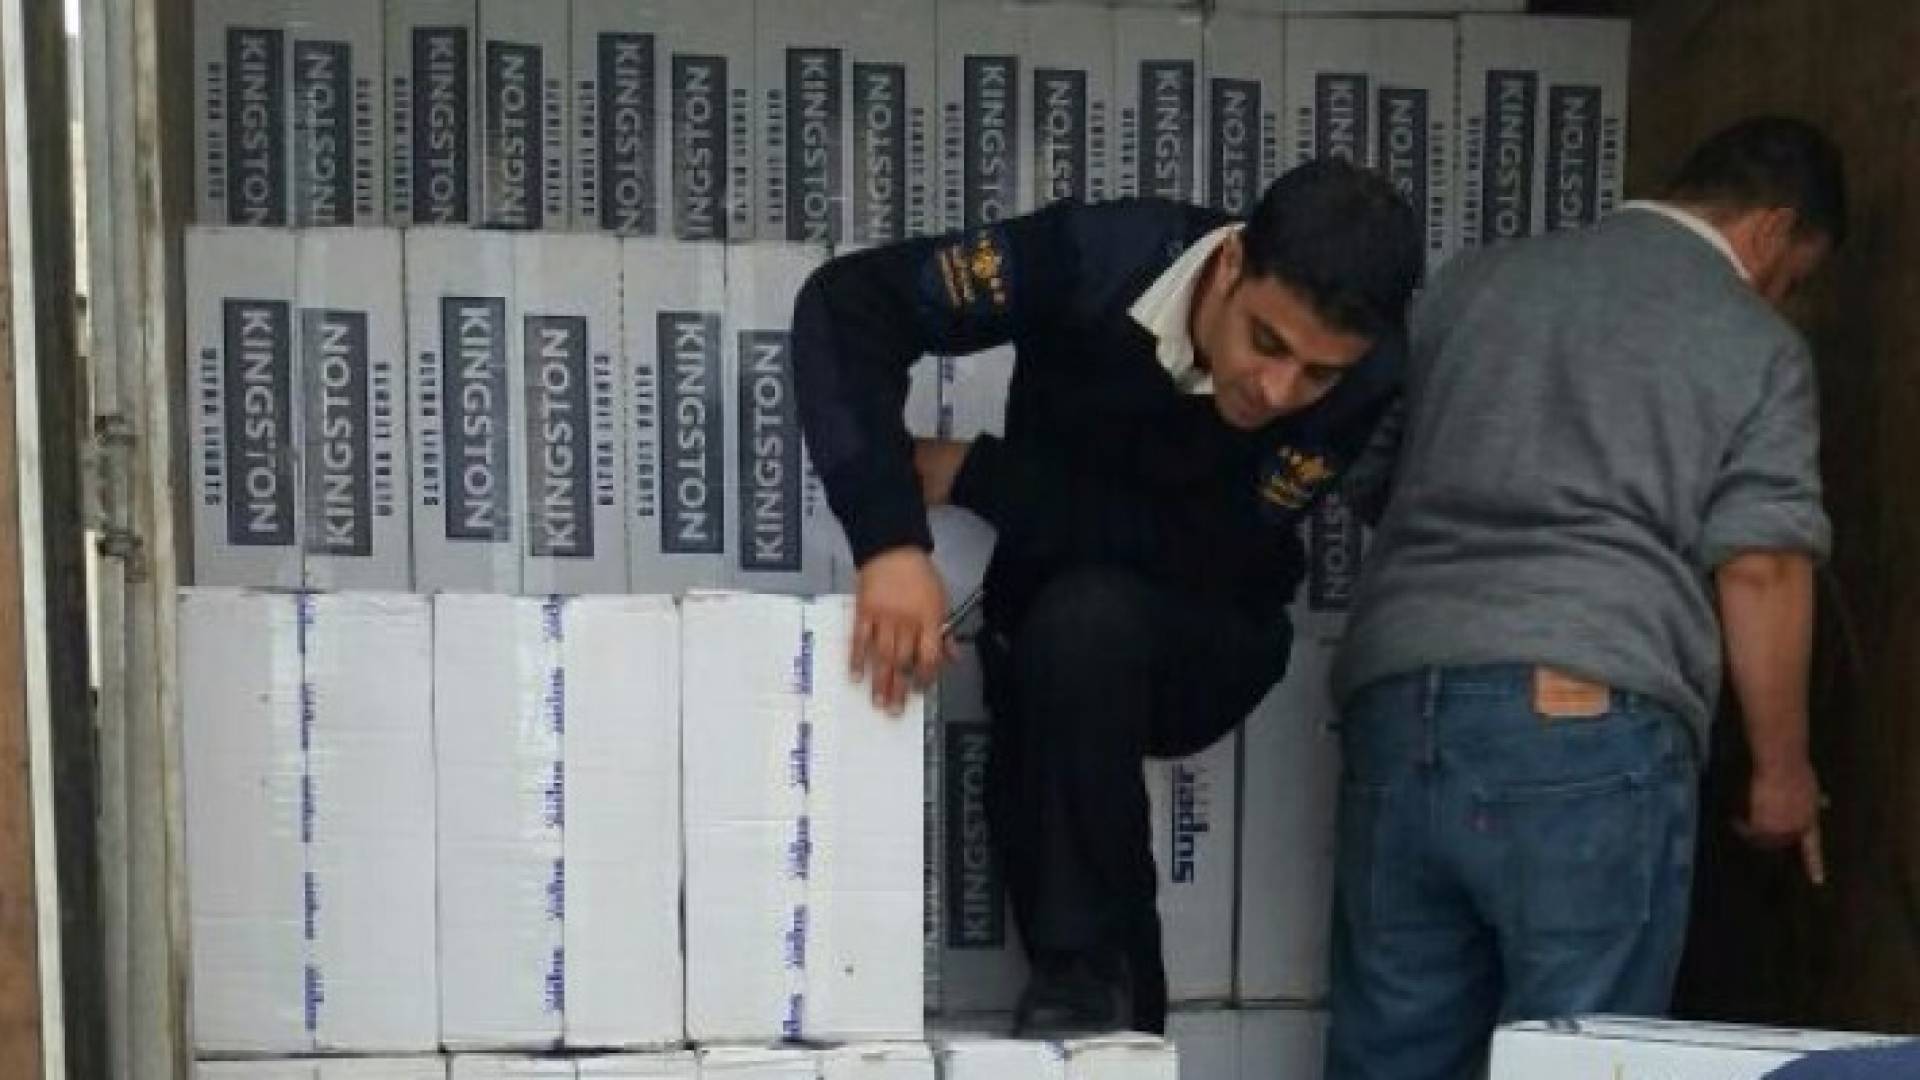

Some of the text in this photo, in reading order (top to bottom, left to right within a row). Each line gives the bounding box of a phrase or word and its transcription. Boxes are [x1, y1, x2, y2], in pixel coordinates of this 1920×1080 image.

[305, 52, 335, 224] INGSTON
[502, 52, 527, 225] INGSTON
[615, 42, 643, 237] KINGSTON
[686, 65, 713, 236] INGSTON
[801, 56, 829, 243] KINGSTON
[866, 74, 892, 238] INGSTON
[980, 66, 1006, 223] KINGSTO
[1048, 80, 1072, 202] GSTON
[1155, 70, 1182, 197] KINGST
[1222, 89, 1246, 213] GSTON
[1497, 80, 1524, 237] KINGSTO
[242, 309, 279, 533] KINGSTON
[322, 322, 355, 546] KINGSTON
[459, 307, 494, 529] KINGSTON
[539, 328, 576, 547] KINGSTON
[674, 323, 706, 541] KINGSTON
[754, 344, 785, 561] KINGSTON
[962, 734, 991, 942] KINGSTON
